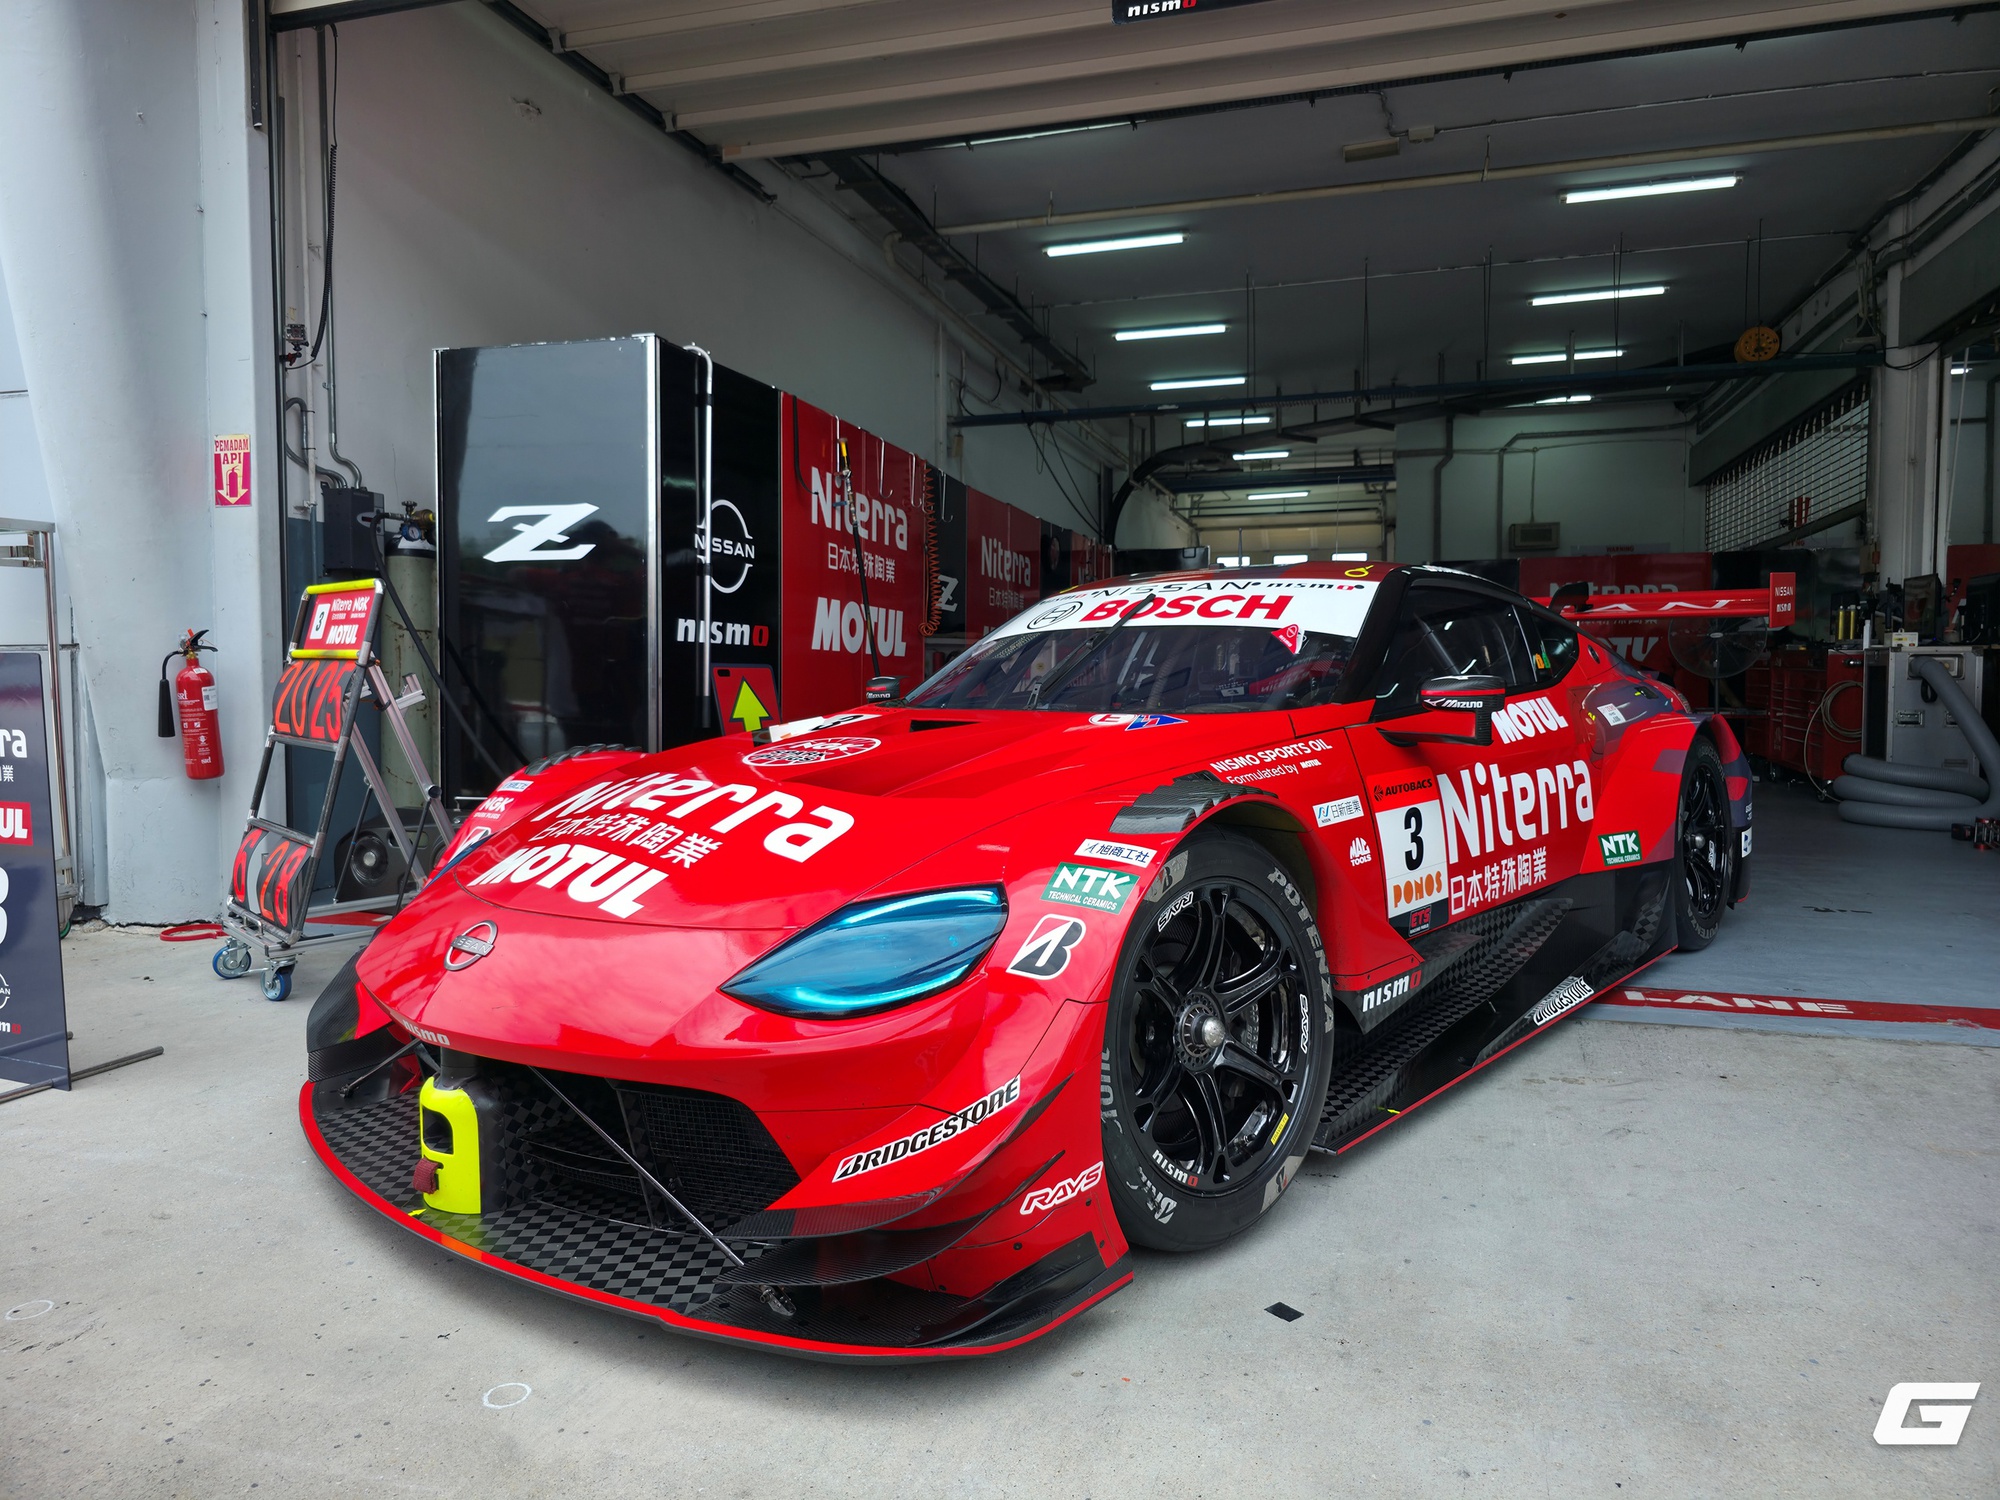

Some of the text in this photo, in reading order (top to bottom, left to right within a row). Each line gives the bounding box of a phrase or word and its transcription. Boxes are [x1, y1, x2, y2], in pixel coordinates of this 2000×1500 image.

[1127, 0, 1197, 17] nismo
[214, 438, 249, 452] PEMADAM
[222, 452, 243, 465] API
[482, 502, 600, 563] Z
[694, 533, 755, 559] NSSAN
[981, 535, 1031, 587] Niterra
[1093, 580, 1253, 599] NISSAN
[1774, 586, 1794, 597] NISSAN
[353, 596, 370, 612] NGK
[1079, 594, 1294, 622] BOSCH
[315, 611, 325, 631] 3
[326, 624, 359, 645] MOTUL
[811, 597, 907, 658] MOTUL
[1491, 696, 1569, 744] MOTUL
[1209, 738, 1333, 773] NISMO SPORTS OIL
[1226, 767, 1285, 785] Formulated
[1285, 763, 1300, 775] by
[1385, 778, 1433, 796] AUTOBACS
[479, 796, 515, 813] NGK
[530, 772, 855, 863] Niterra
[1436, 759, 1595, 865] Niterra
[1349, 837, 1371, 859] MAC
[1404, 806, 1424, 871] 3
[1600, 832, 1640, 856] NTK
[1099, 843, 1150, 864] 旭商工社
[1350, 854, 1372, 866] TOOLS
[468, 844, 669, 919] MOTUL
[1052, 865, 1131, 900] NTK
[1392, 870, 1443, 908] PONOS
[1450, 846, 1547, 916] 日本特殊陶業
[1048, 890, 1118, 911] TECHNICAL CERAMICS
[1410, 906, 1431, 928] ETS
[1267, 866, 1335, 1034] POTENZA
[1362, 969, 1422, 1013] nismo
[1534, 978, 1594, 1025] BRIDGESTONE
[1624, 990, 1855, 1014] LANE
[834, 1077, 1020, 1182] BRIDGESTONE
[1152, 1149, 1199, 1188] nismo
[1020, 1161, 1103, 1215] RAYS
